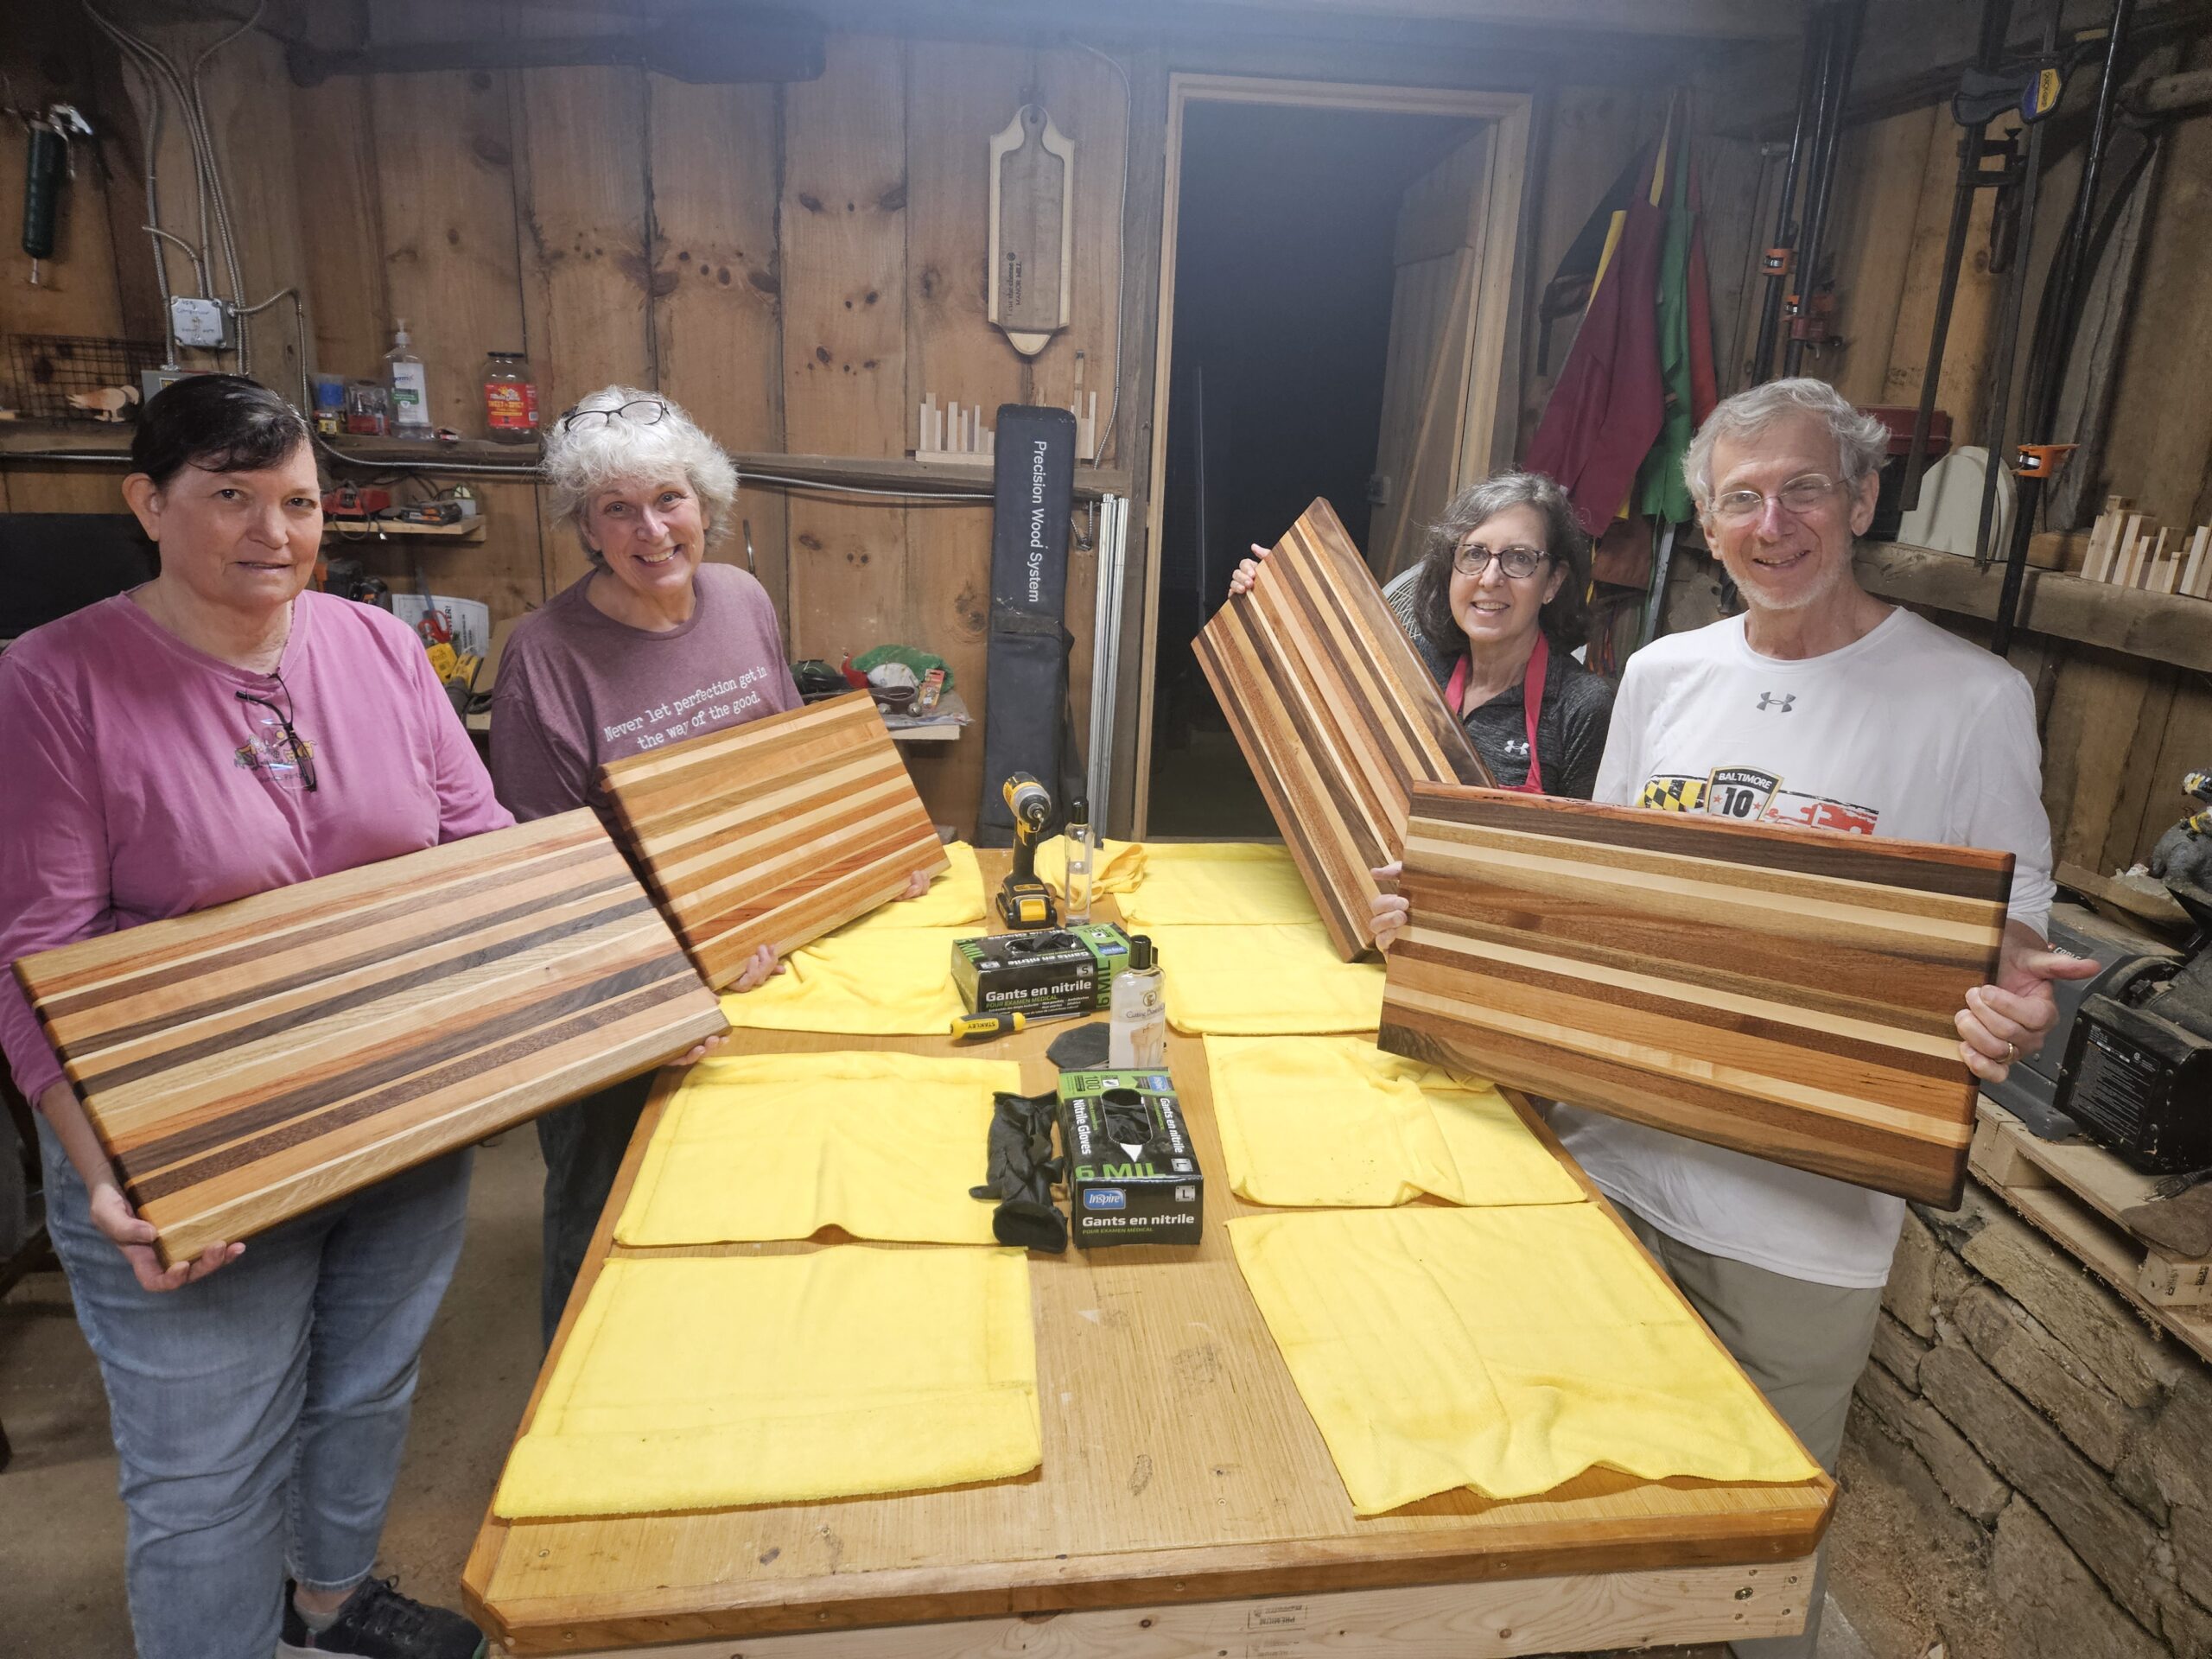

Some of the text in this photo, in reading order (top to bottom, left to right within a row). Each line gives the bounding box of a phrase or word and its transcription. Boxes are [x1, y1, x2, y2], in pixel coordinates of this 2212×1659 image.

[1027, 441, 1047, 602] Precision Wood System
[604, 665, 767, 742] Never let perfection get in
[637, 690, 761, 750] the way of the good.
[1718, 772, 1772, 789] BALTIMORE
[1722, 786, 1755, 818] 10
[1007, 957, 1040, 966] nitrile
[1057, 951, 1090, 960] Gants
[1082, 966, 1089, 975] S
[986, 980, 1091, 1002] Gants en nitrile
[1097, 960, 1111, 1007] 6 MIL
[1004, 999, 1031, 1007] EXAMEN
[1031, 995, 1058, 1003] MÉDICAL
[968, 1020, 995, 1030] STANLEY
[1084, 1075, 1101, 1090] 100
[1073, 1099, 1089, 1125] Nitrile
[1160, 1097, 1185, 1154] Gants en nitrile
[1077, 1126, 1091, 1155] Gloves
[1075, 1163, 1166, 1179] 6 MIL
[1089, 1193, 1121, 1205] Inspire
[1182, 1189, 1190, 1198] L
[1082, 1214, 1195, 1227] Gants en nitrile
